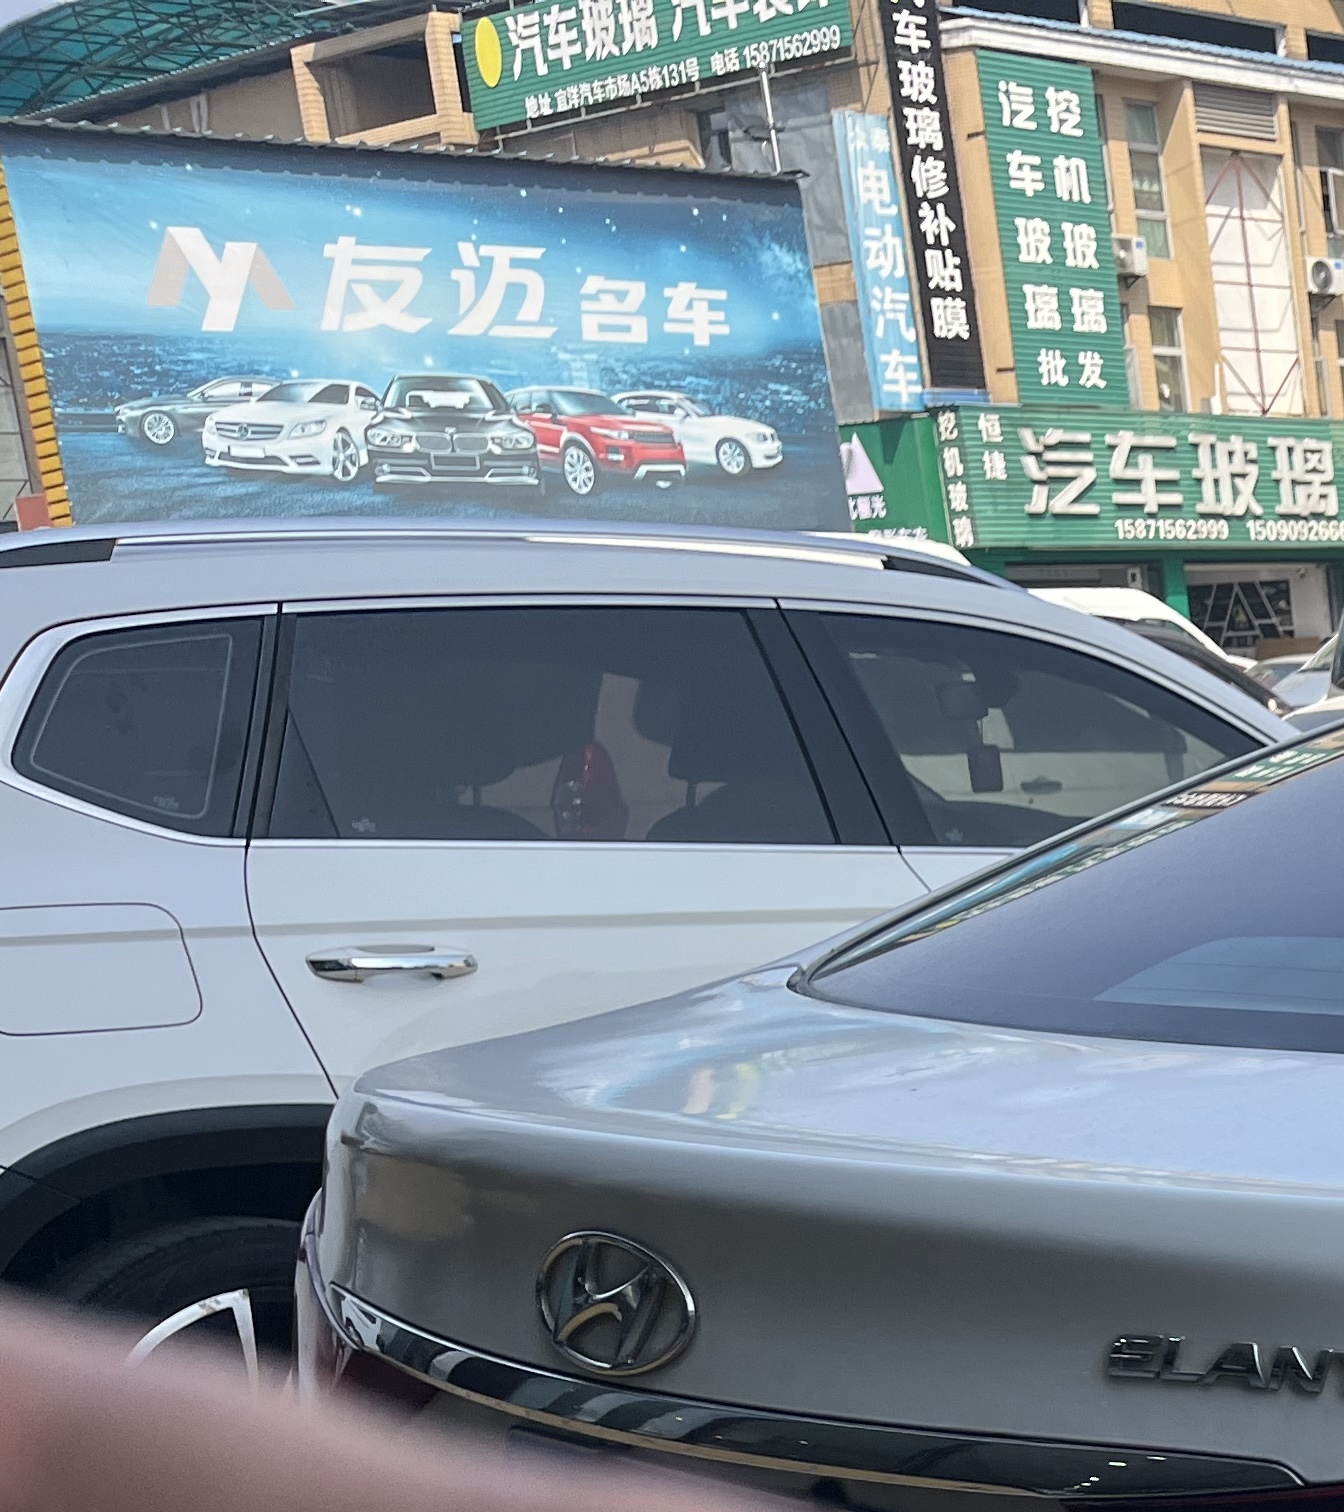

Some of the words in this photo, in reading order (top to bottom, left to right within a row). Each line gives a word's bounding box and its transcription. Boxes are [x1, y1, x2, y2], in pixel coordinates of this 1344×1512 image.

[504, 0, 658, 81] 汽车玻璃
[524, 94, 553, 118] 地址
[710, 46, 740, 76] 电话
[742, 25, 841, 69] 15871562999
[889, 0, 971, 341] 车玻璃修补贴膜
[998, 79, 1063, 332] 汽车玻璃
[1043, 86, 1109, 335] 挖机玻璃
[857, 159, 923, 404] 电动汽车
[1036, 348, 1108, 390] 批发
[1017, 426, 1340, 517] 汽车玻璃
